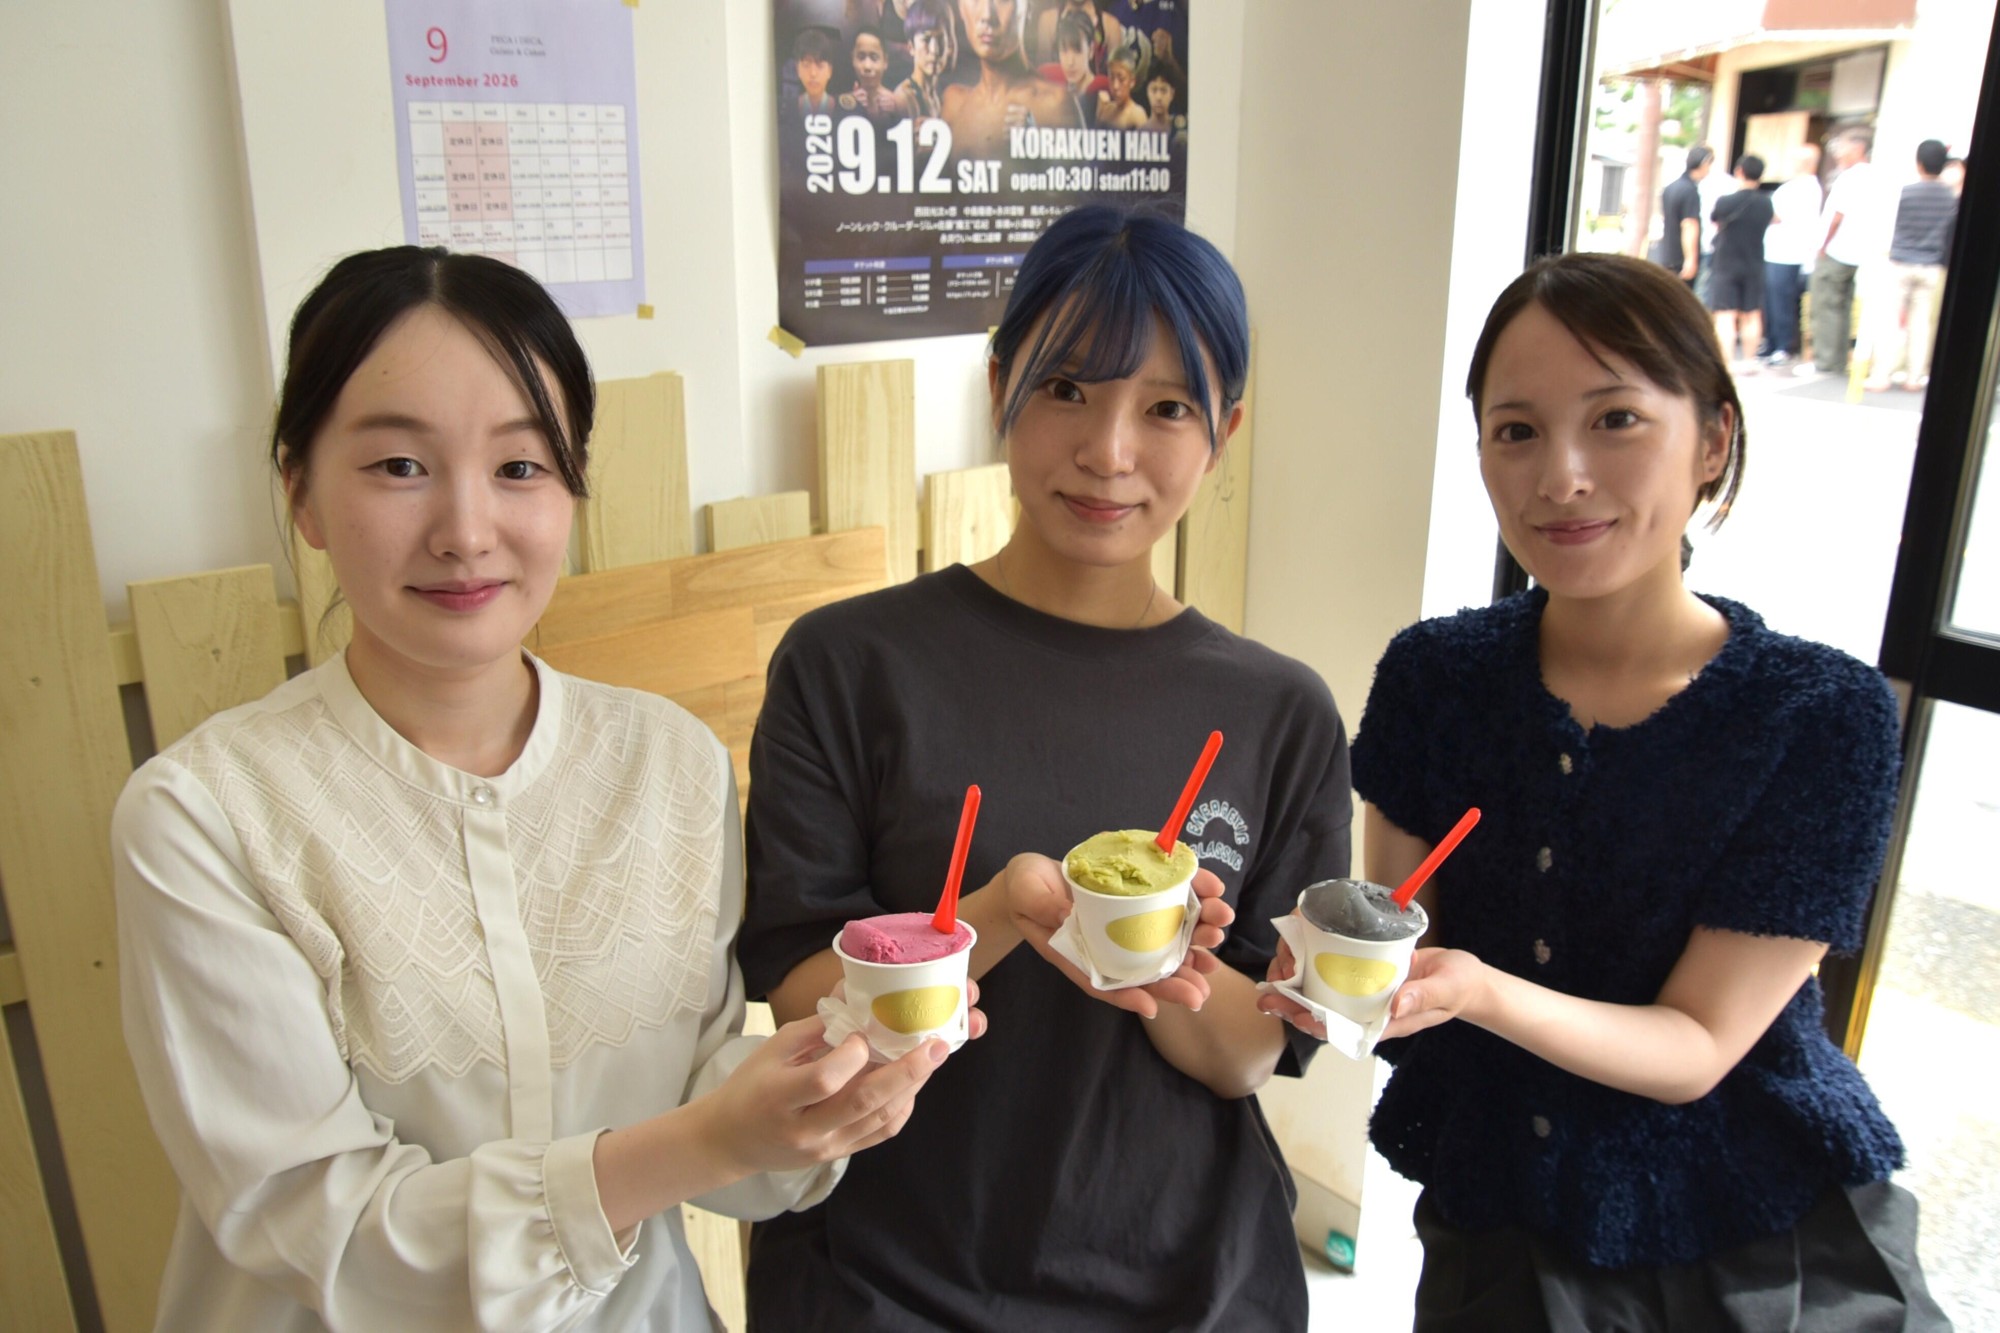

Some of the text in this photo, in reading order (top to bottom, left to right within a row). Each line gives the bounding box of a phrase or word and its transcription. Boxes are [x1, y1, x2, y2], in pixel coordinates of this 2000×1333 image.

[426, 26, 448, 64] 9
[405, 73, 519, 88] September 2026
[804, 114, 1002, 194] 2026 9.12 SAT
[1009, 126, 1170, 162] KORAKUEN HALL
